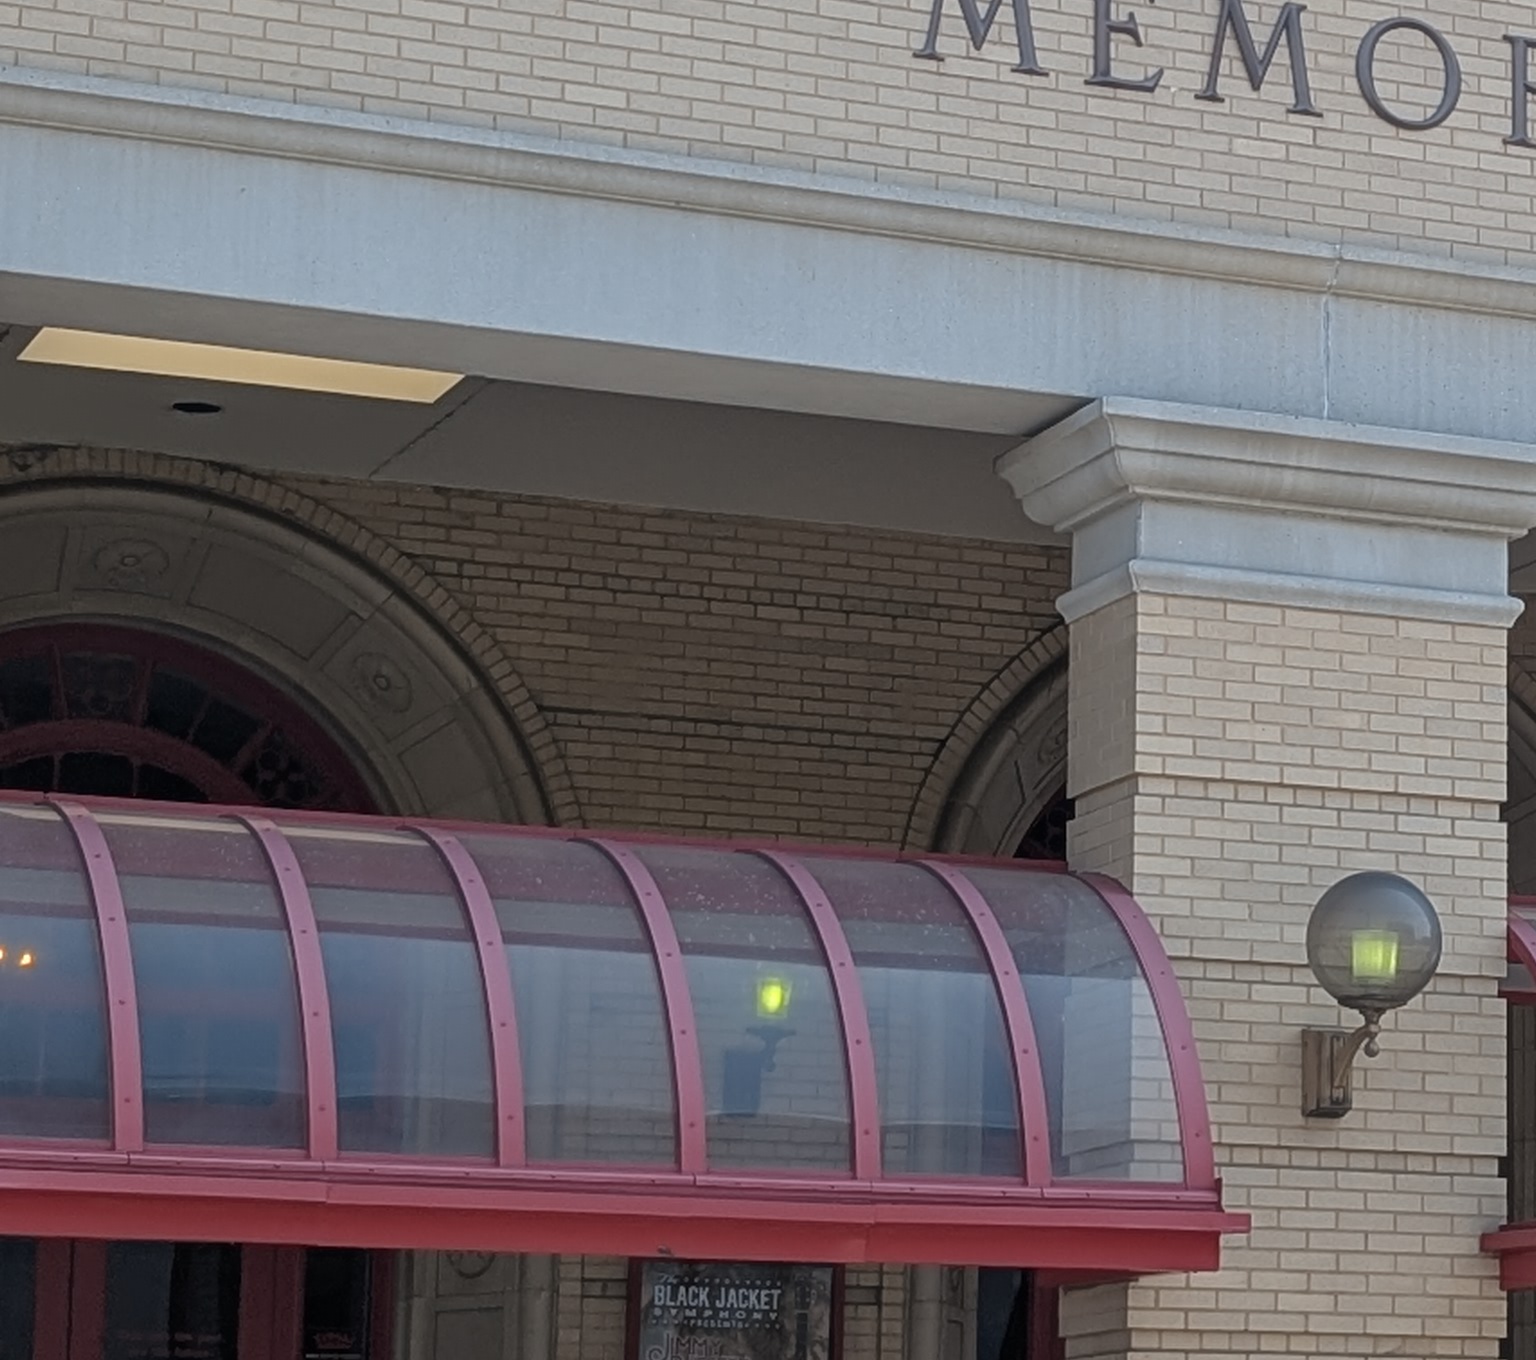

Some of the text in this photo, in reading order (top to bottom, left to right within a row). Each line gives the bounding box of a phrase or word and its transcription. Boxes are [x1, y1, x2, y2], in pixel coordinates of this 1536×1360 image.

[654, 1285, 781, 1310] BLACK JACKET
[653, 1307, 778, 1320] SYMPHONY
